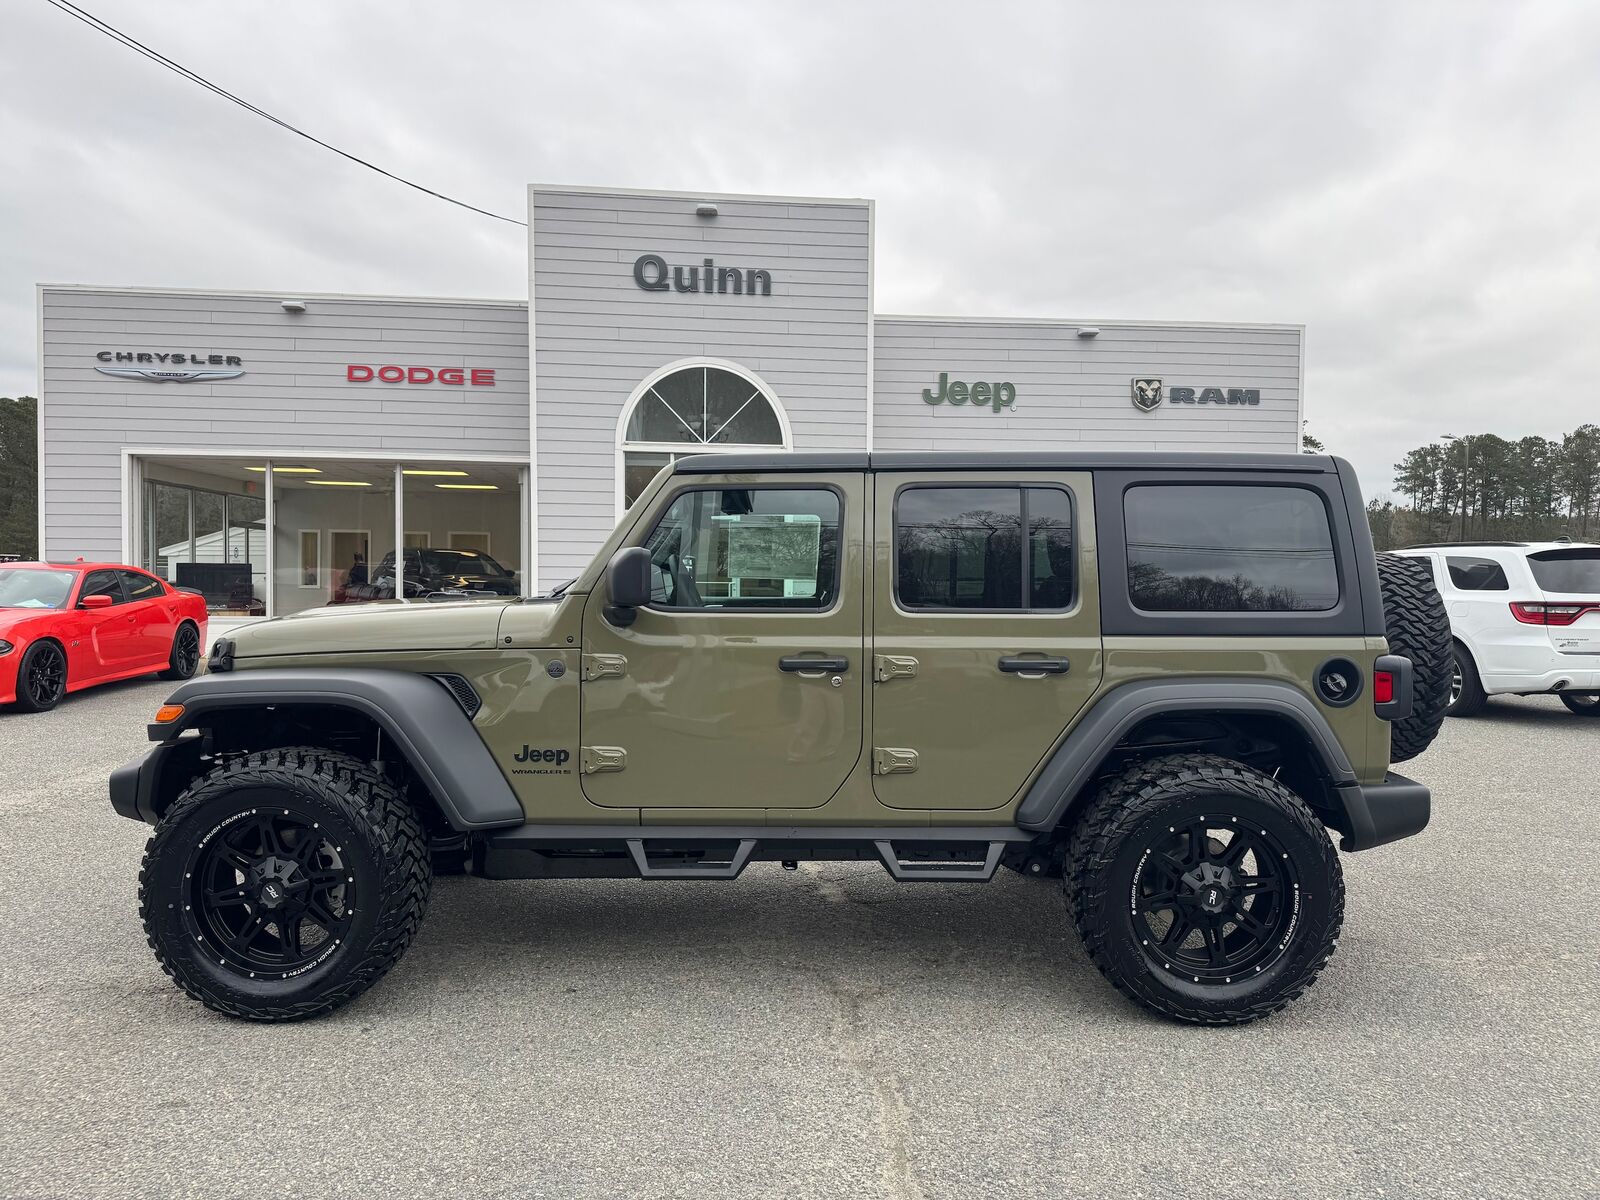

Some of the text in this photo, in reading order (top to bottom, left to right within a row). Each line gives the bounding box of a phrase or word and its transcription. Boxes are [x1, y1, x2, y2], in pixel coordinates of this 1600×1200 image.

[633, 254, 772, 296] Quinn
[96, 351, 242, 366] CHRYSLER
[347, 365, 496, 386] DODGE
[922, 372, 1016, 413] Jeep
[1169, 387, 1260, 406] RAM
[514, 744, 570, 766] Jeep
[202, 810, 251, 844] ROUGH COUNTRY
[1133, 853, 1148, 884] COUNTRY
[1208, 889, 1217, 905] RC
[1282, 914, 1298, 945] COUNTRY
[288, 944, 336, 977] ROUGH COUNTRY
